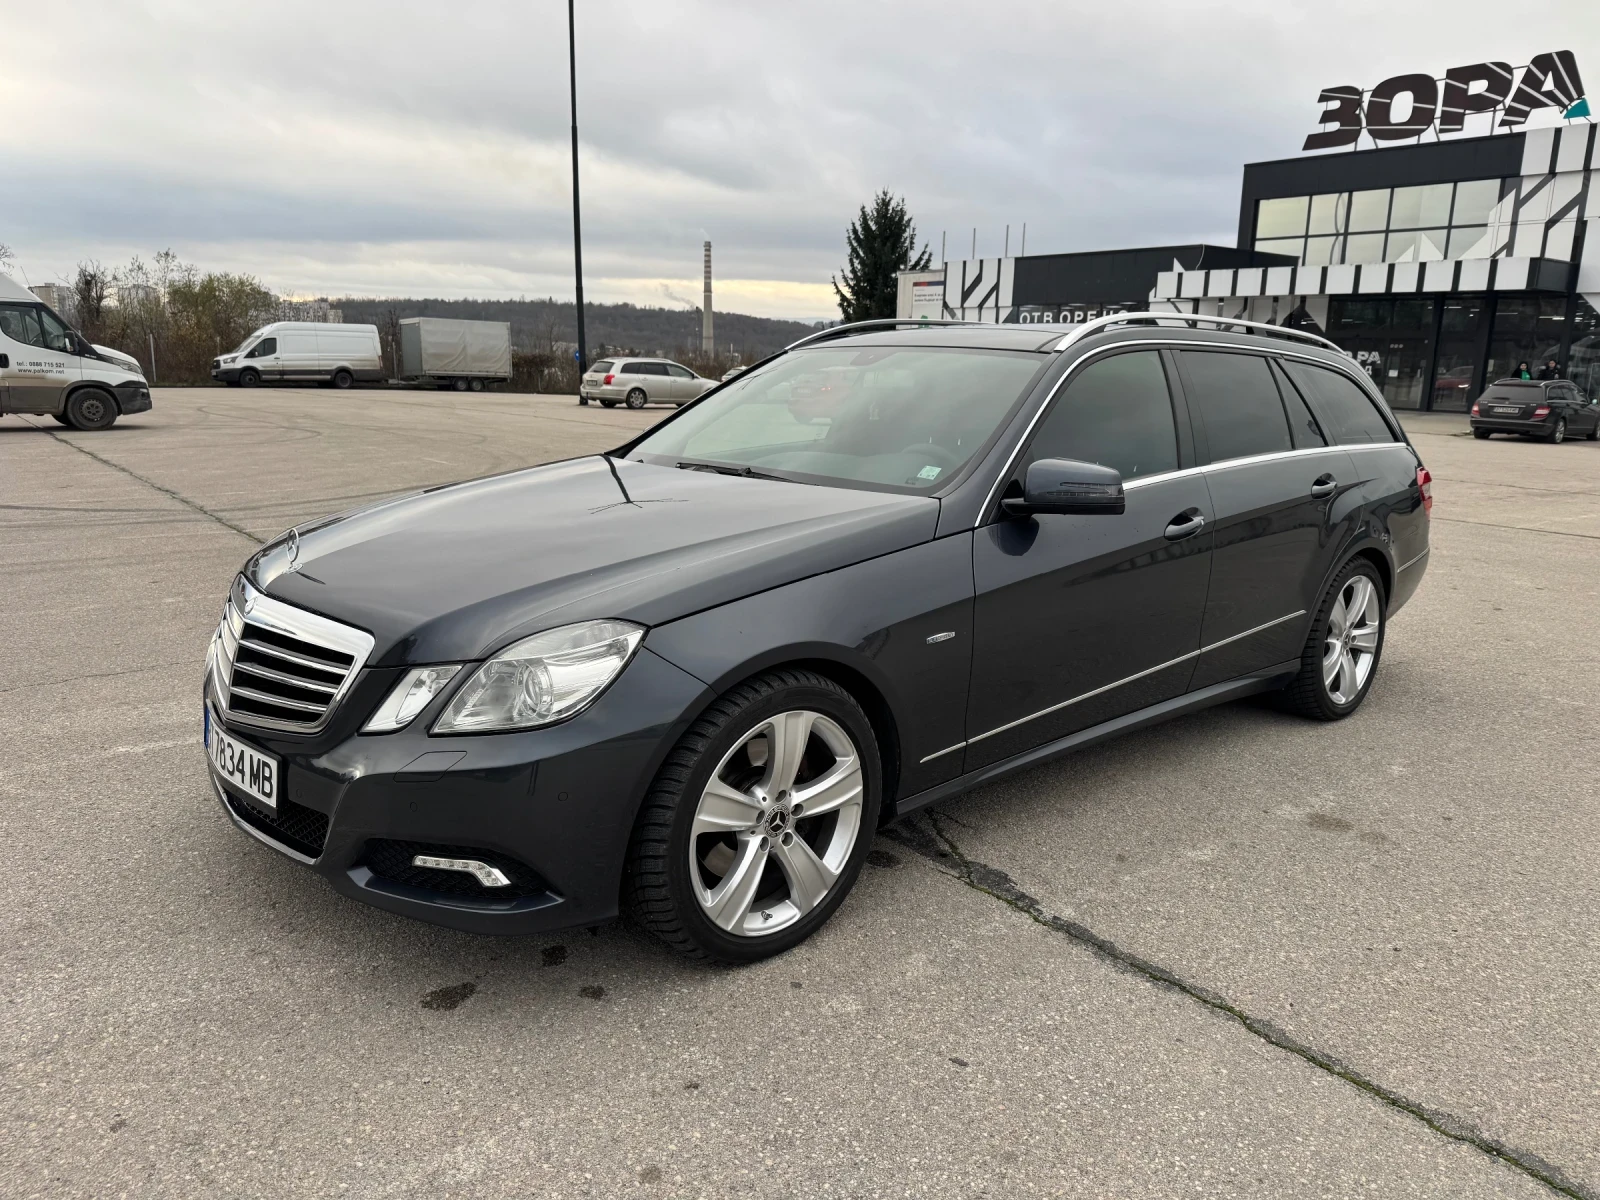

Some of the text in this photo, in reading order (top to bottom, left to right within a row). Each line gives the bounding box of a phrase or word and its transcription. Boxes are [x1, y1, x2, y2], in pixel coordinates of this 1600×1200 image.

[1302, 50, 1590, 151] ЗОРА
[215, 730, 246, 784] 7834
[249, 753, 273, 798] MB
